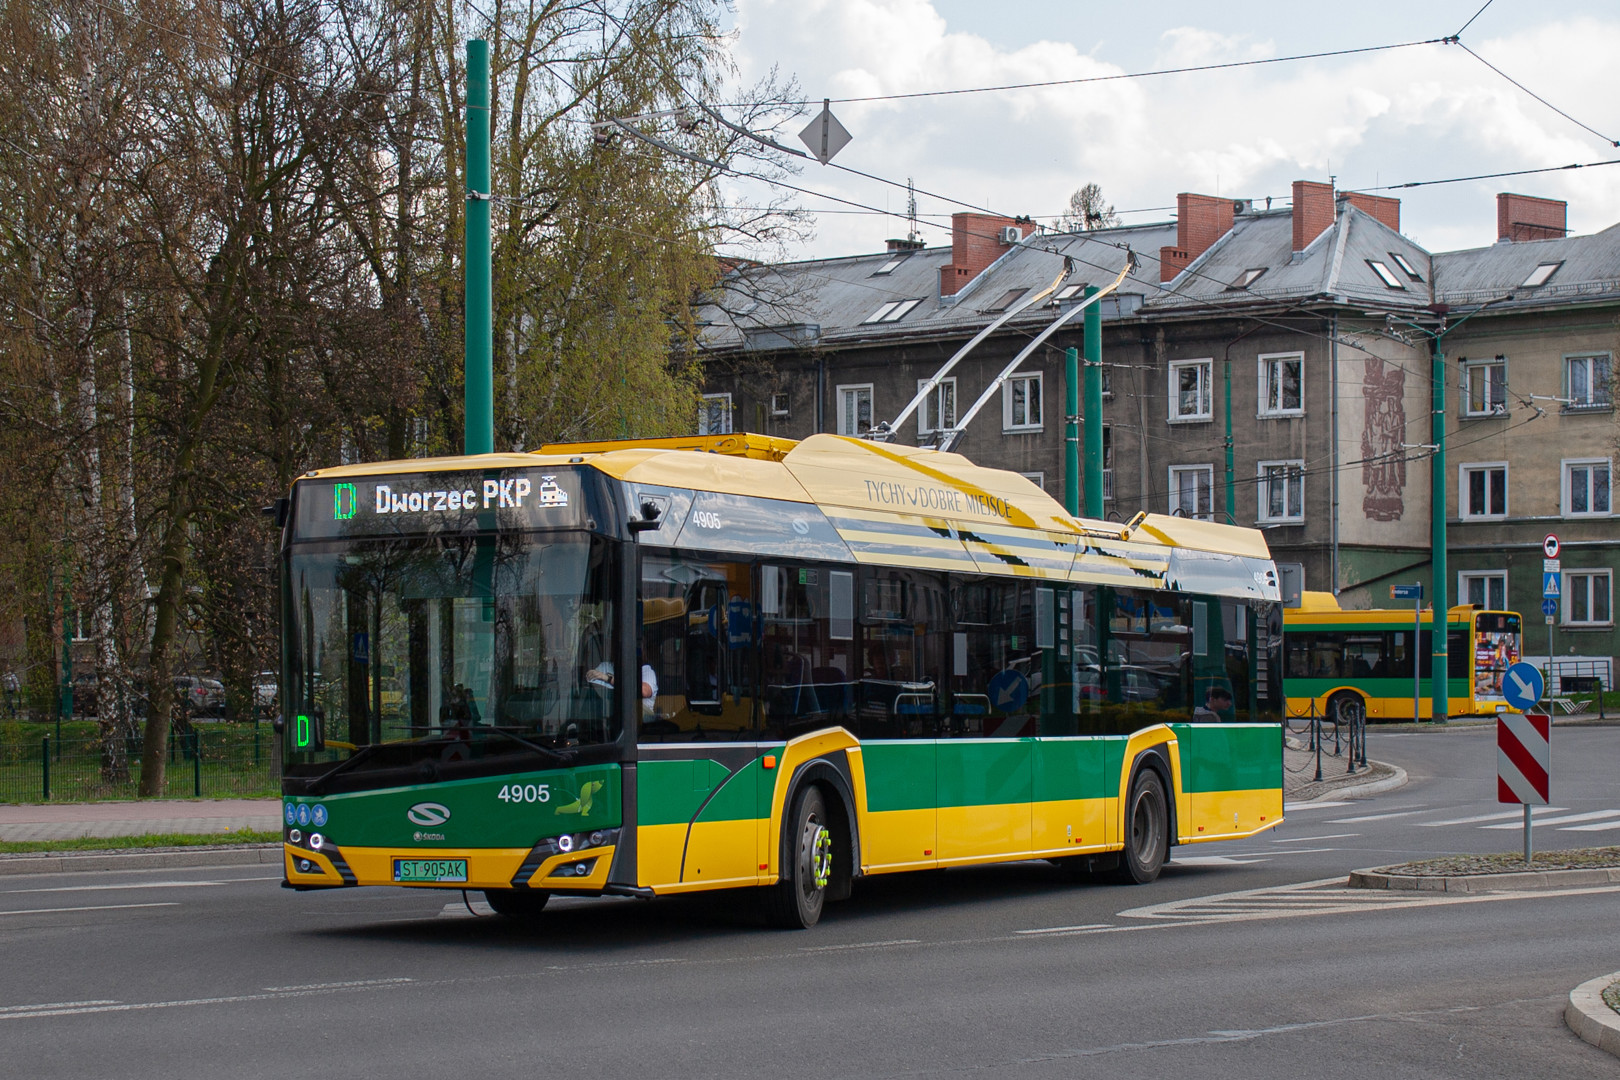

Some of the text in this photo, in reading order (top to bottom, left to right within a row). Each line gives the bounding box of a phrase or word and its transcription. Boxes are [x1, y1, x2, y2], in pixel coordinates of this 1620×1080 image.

[334, 478, 531, 520] D Dworzec PKP
[863, 479, 1013, 519] TYCHY DOBRE MIEJSCE
[692, 510, 721, 530] 4905
[297, 715, 309, 747] D
[497, 784, 550, 803] 4905
[402, 862, 463, 877] ST 905AK
